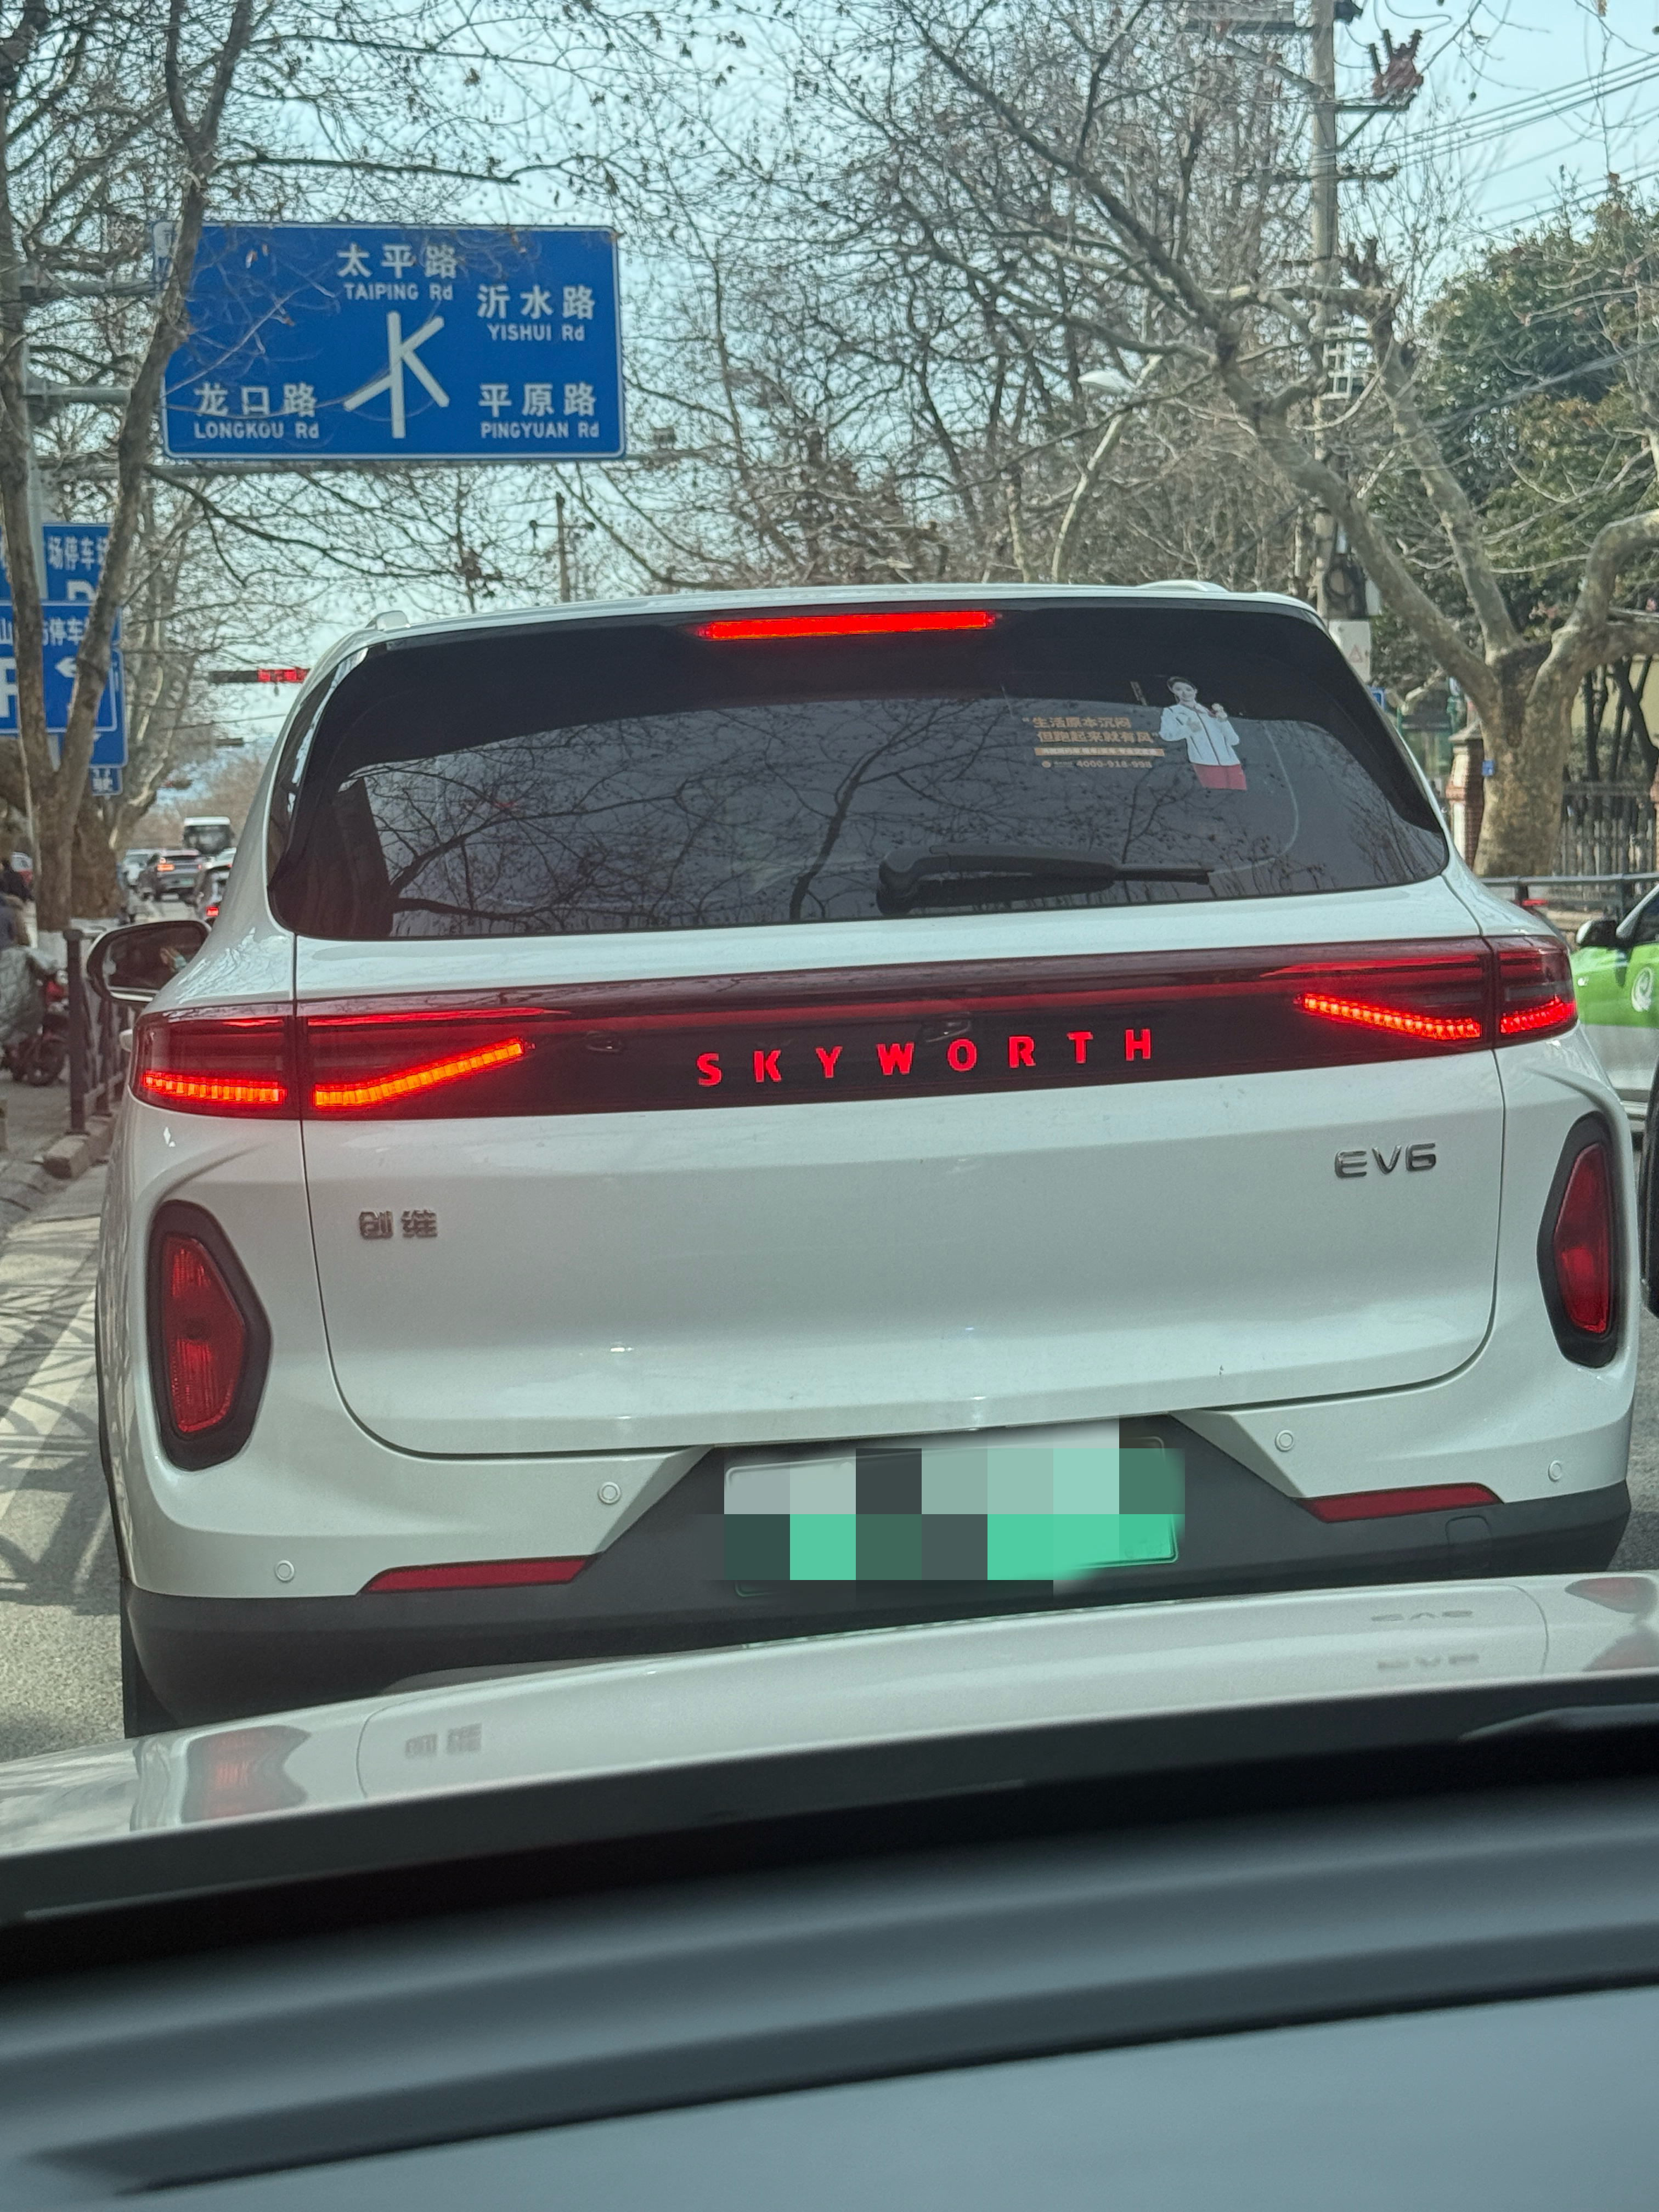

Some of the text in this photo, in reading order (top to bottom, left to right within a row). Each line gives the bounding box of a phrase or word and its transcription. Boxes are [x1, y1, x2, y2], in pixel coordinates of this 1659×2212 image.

[336, 242, 458, 279] 太平路
[345, 283, 453, 301] TAIPING Rd
[477, 284, 595, 320] 沂水路
[487, 324, 585, 341] YISHUI Rd
[194, 382, 317, 417] 龙口路
[478, 383, 596, 417] 平原路
[194, 421, 319, 439] LONGKOU Rd
[481, 421, 599, 438] PINGYUAN Rd
[696, 1029, 1153, 1087] SKYWORTH
[1334, 1142, 1436, 1178] EV6
[358, 1209, 438, 1240] 创维
